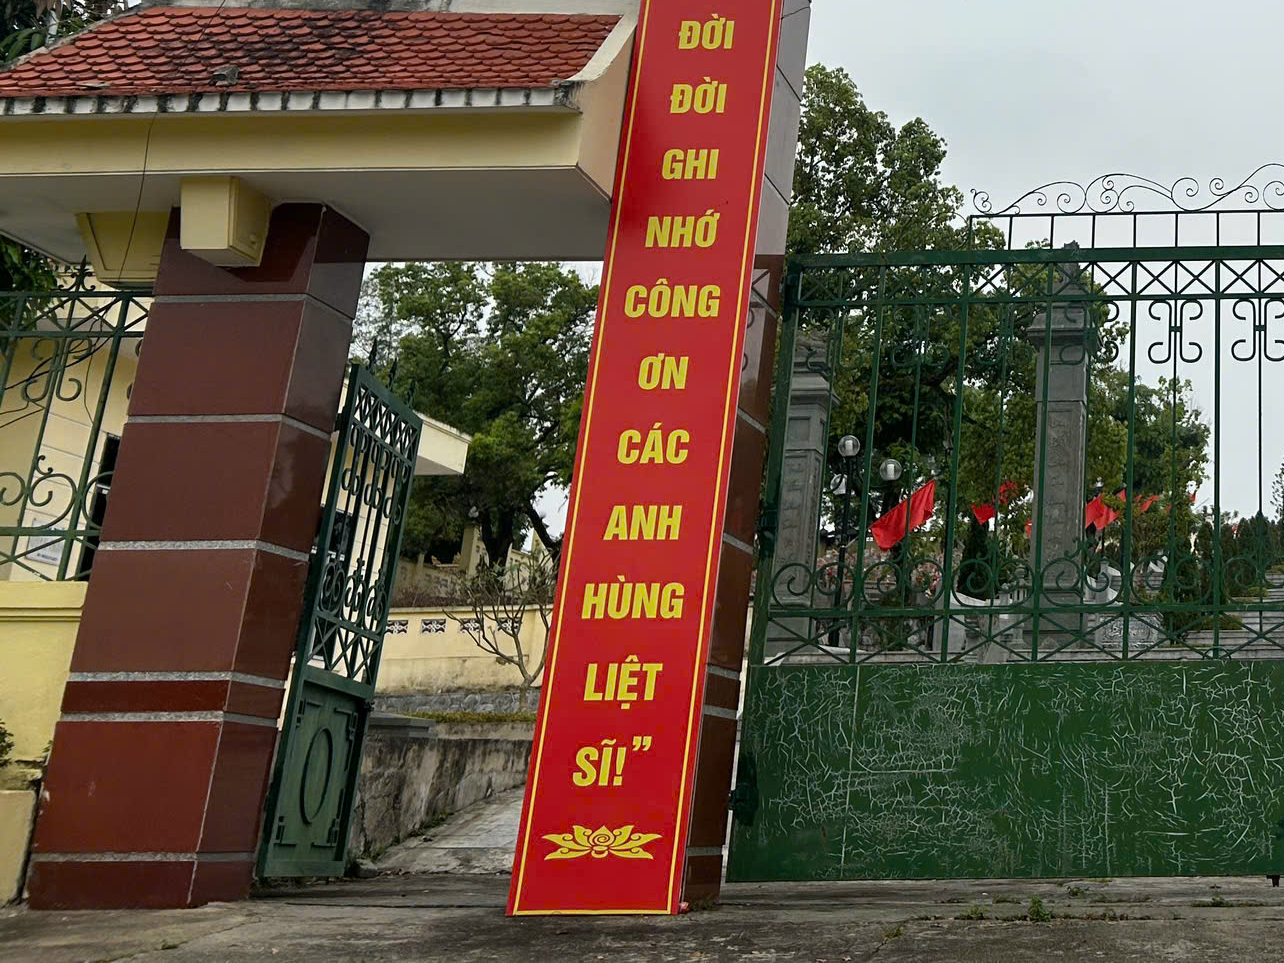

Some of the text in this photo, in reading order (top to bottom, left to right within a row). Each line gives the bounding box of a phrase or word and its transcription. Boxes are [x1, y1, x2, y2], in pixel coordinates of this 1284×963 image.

[678, 13, 735, 50] ĐỜI
[669, 76, 728, 114] ĐỜI
[661, 148, 720, 180] GHI
[644, 208, 721, 248] NHỚ
[624, 277, 721, 318] CÔNG
[637, 352, 690, 391] ƠN
[617, 422, 691, 465] CÁC
[603, 504, 683, 541] ANH
[581, 574, 685, 620] HÙNG
[583, 654, 664, 710] LIỆT
